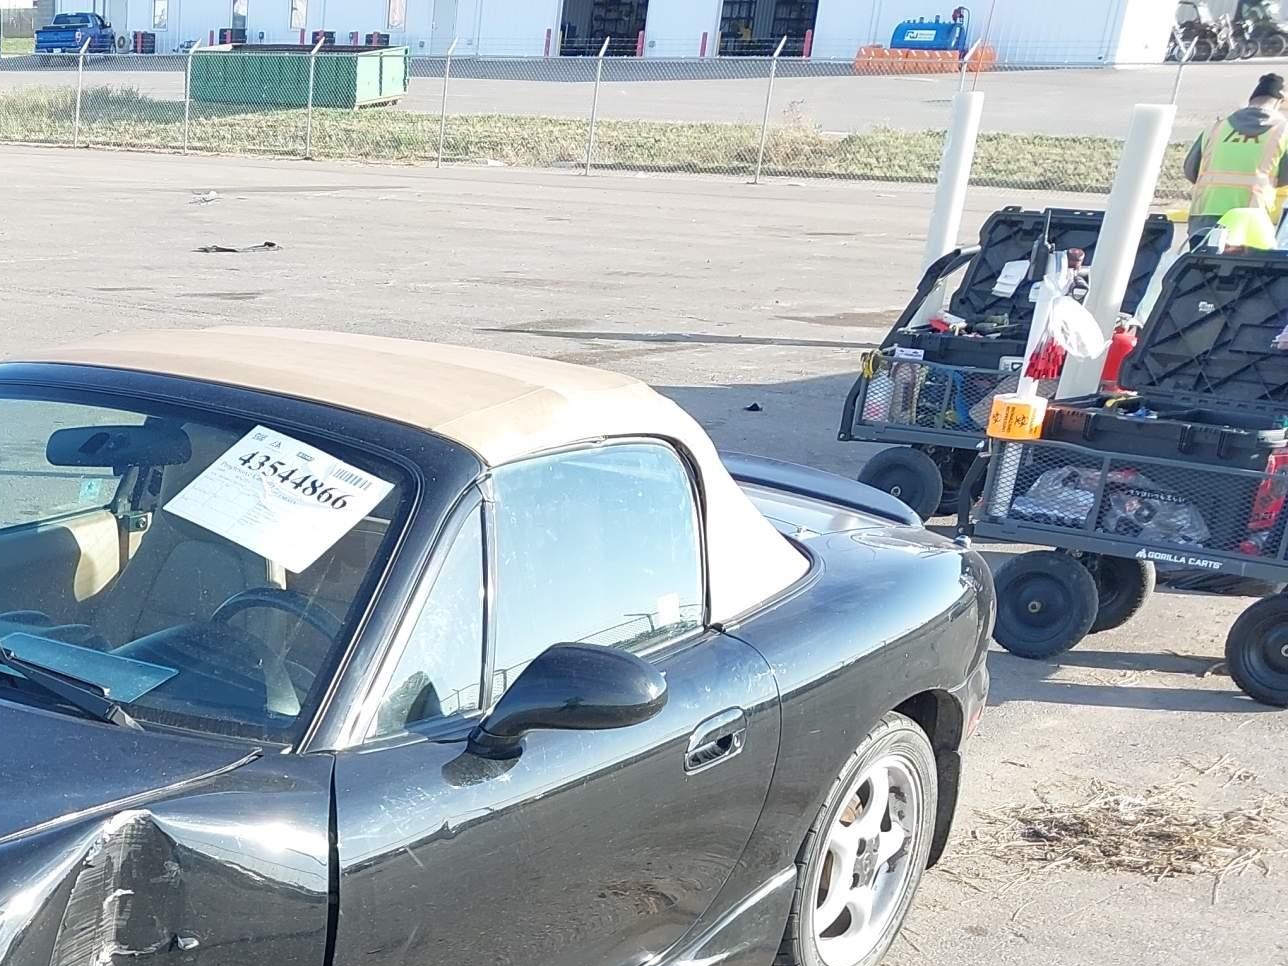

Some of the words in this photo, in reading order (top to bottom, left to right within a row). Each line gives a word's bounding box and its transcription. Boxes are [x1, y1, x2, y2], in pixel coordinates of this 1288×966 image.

[239, 452, 352, 509] 43544866
[1147, 551, 1186, 564] GORILLA
[1188, 558, 1220, 569] CARTS
